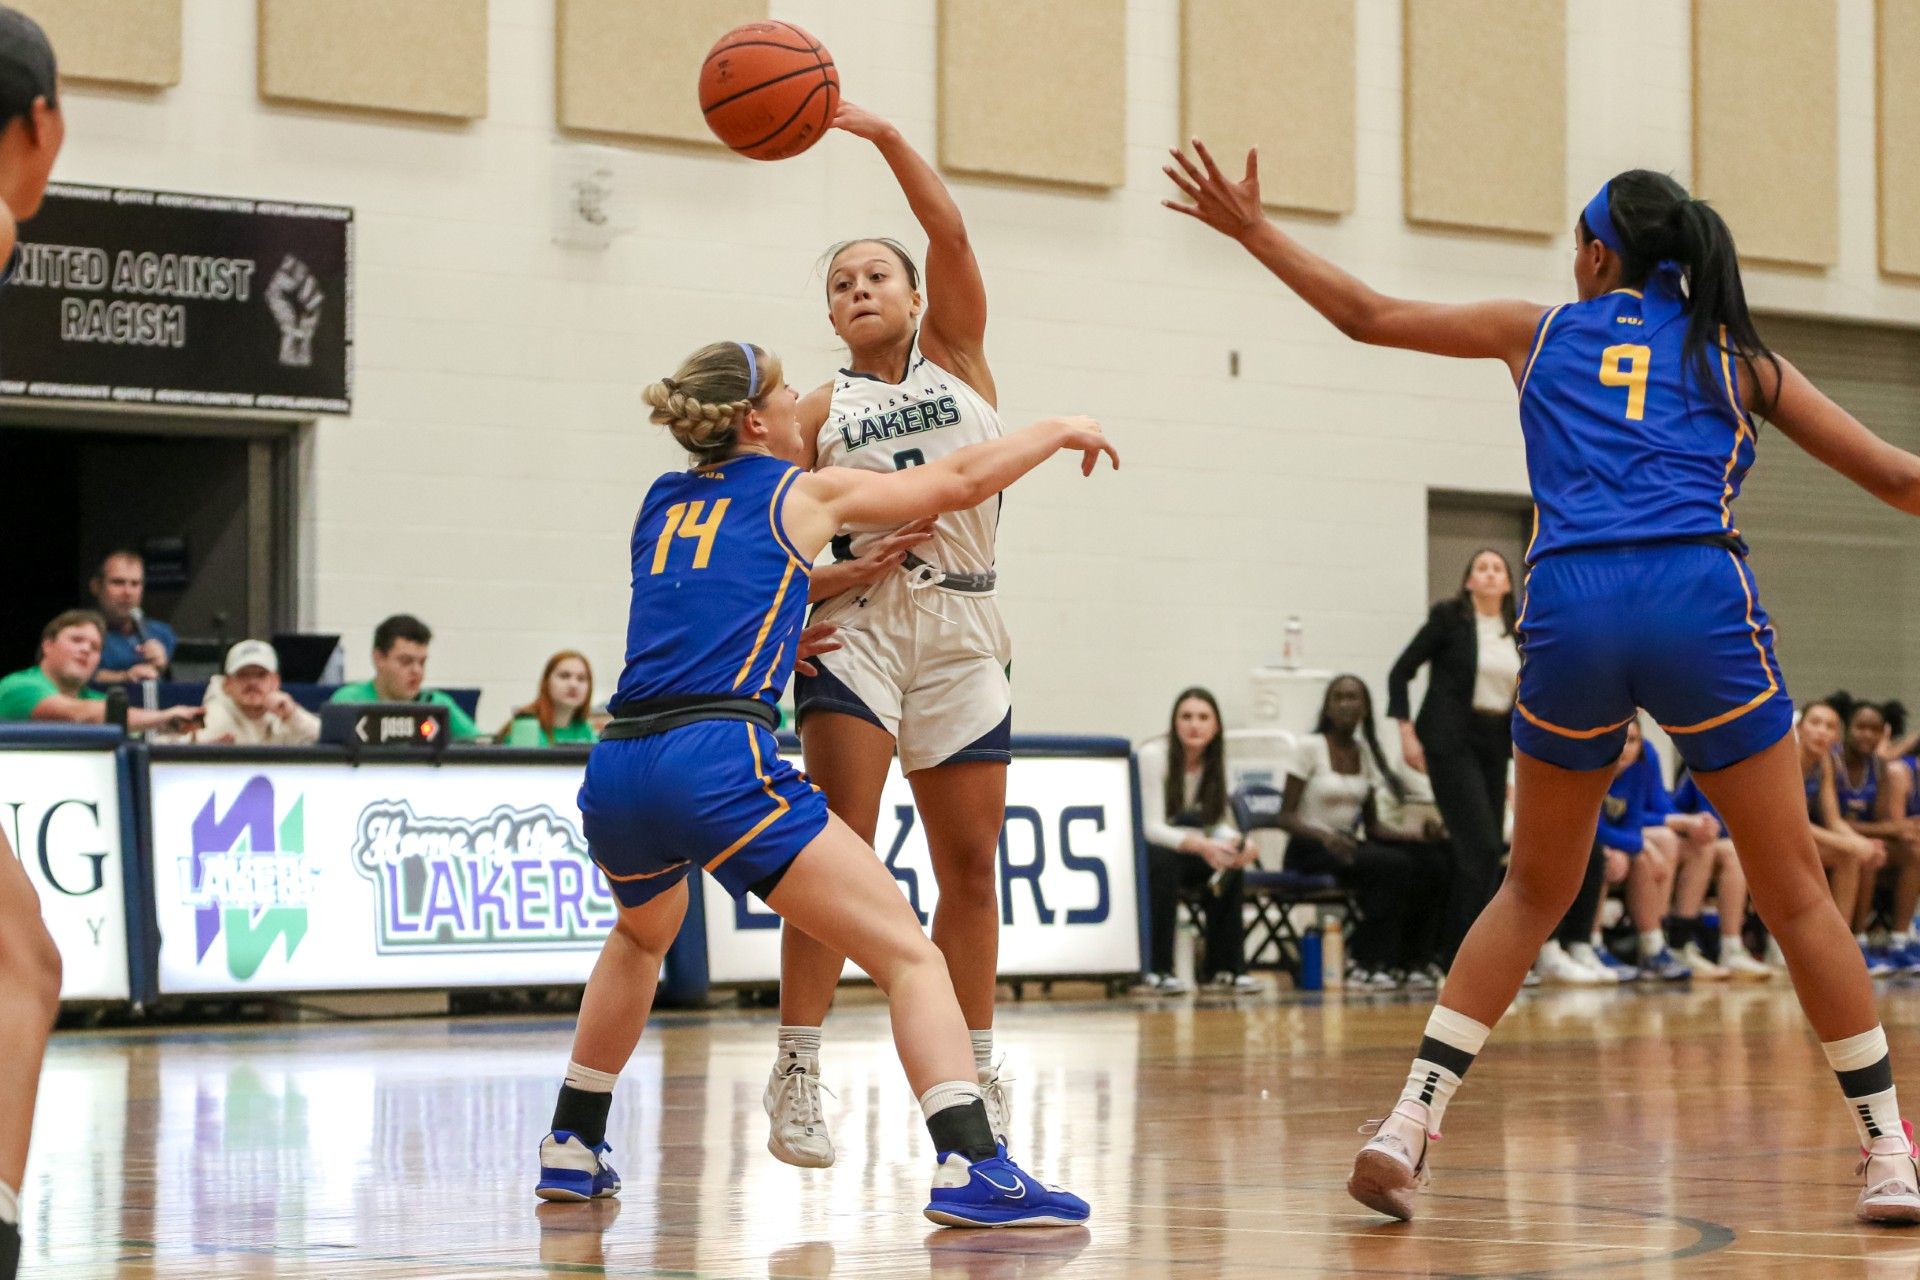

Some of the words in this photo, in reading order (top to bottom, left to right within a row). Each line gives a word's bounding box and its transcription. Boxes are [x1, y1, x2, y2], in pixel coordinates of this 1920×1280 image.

[112, 250, 255, 301] AGAINST
[61, 297, 186, 347] RACISM
[1599, 343, 1651, 421] 9
[839, 395, 961, 452] LAKERS
[651, 498, 732, 576] 14
[363, 817, 469, 865] Home
[475, 820, 515, 866] of
[517, 821, 568, 857] the
[386, 859, 617, 932] LAKERS
